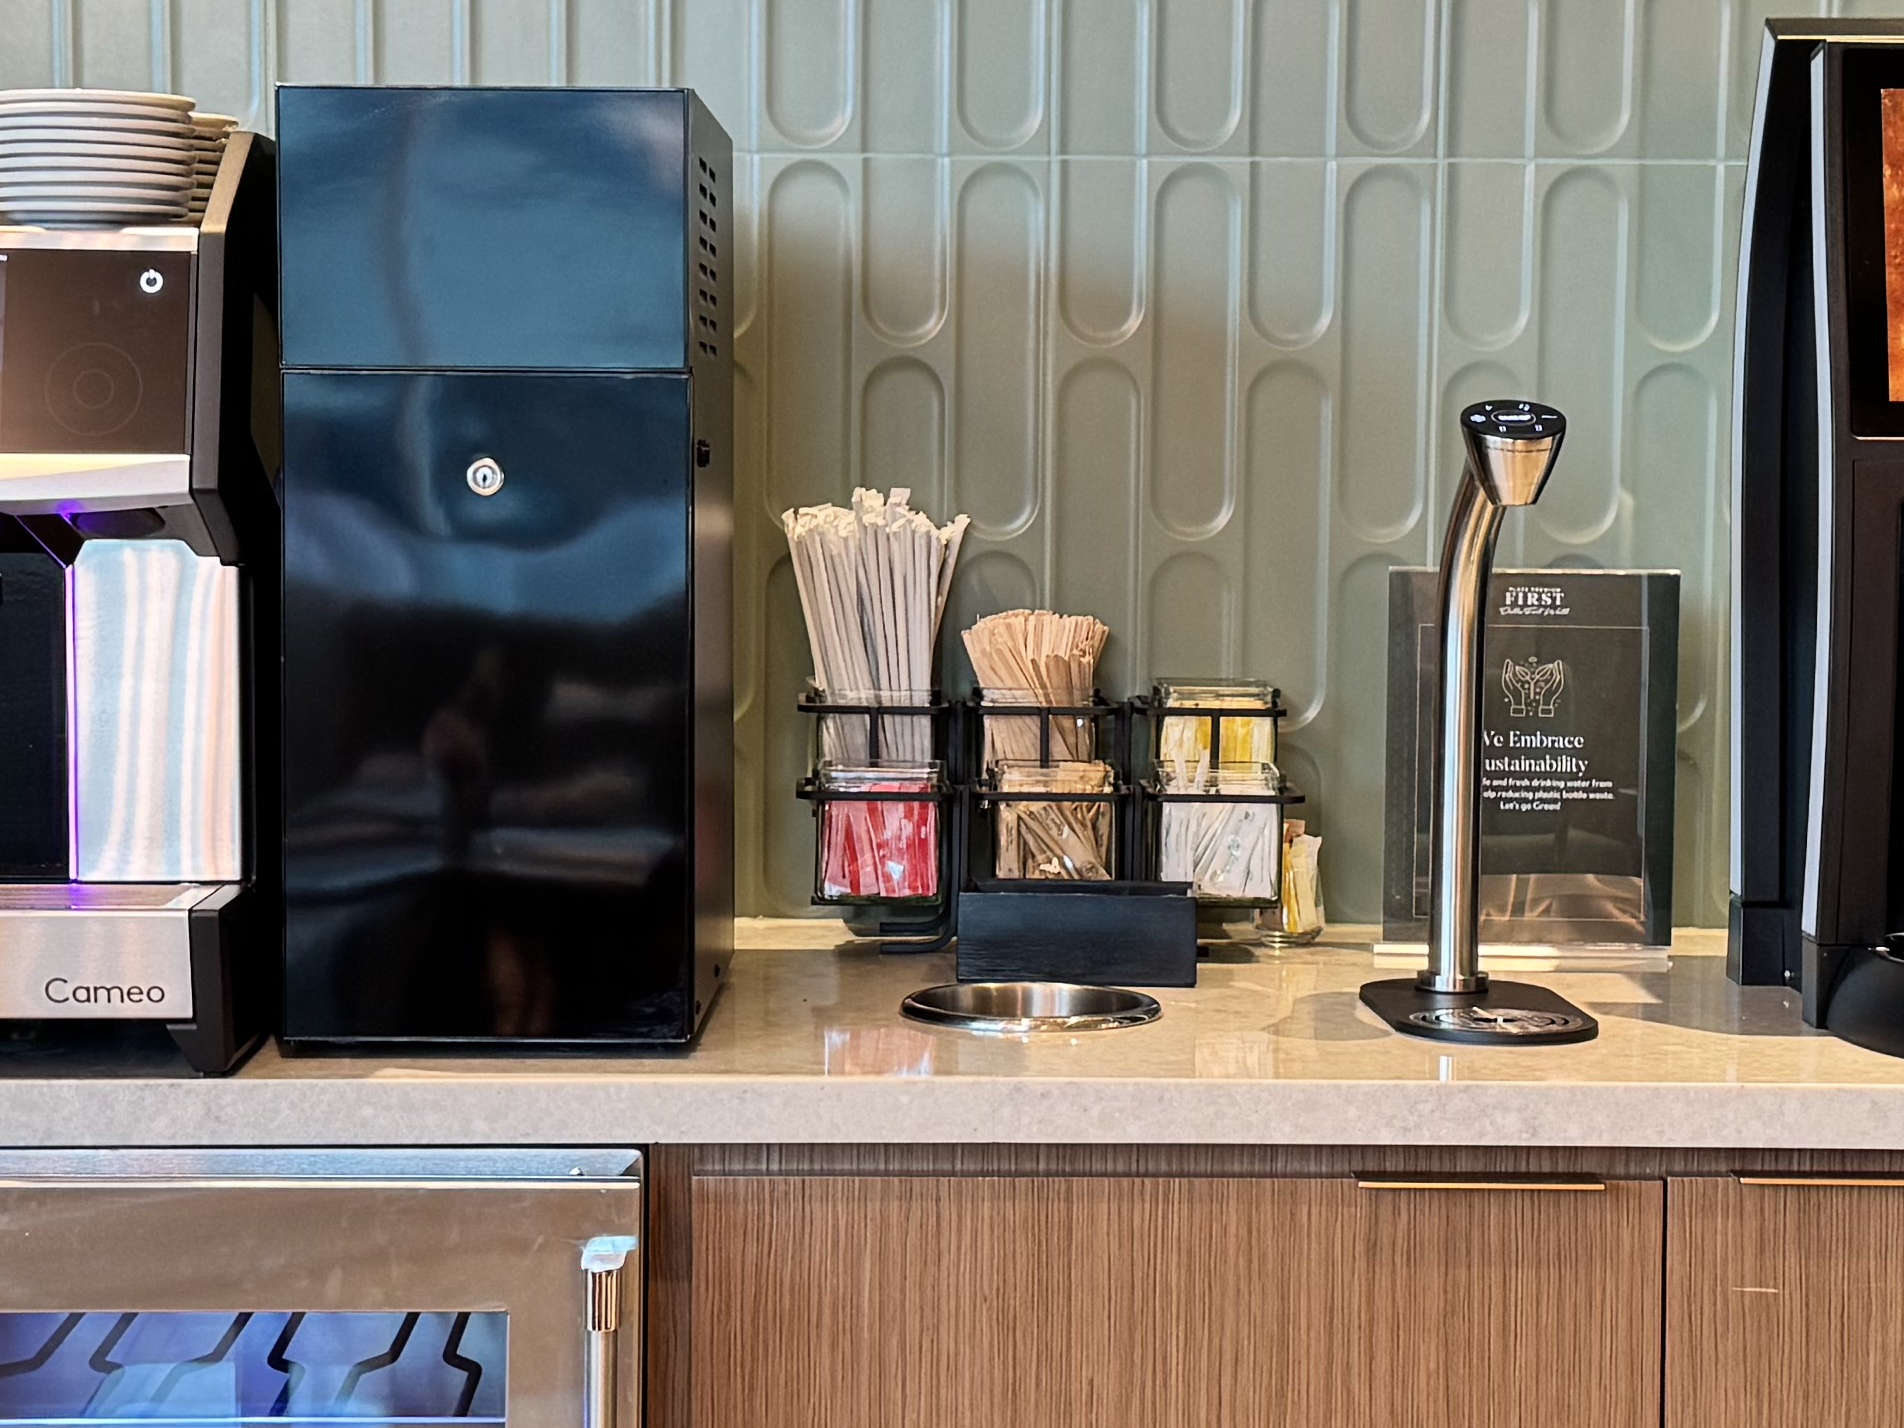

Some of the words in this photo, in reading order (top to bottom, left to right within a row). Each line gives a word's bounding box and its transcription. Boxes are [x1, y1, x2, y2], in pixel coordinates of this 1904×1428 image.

[1505, 592, 1564, 605] FIRST
[1510, 731, 1584, 748] Embrace
[1485, 755, 1588, 777] ustainability
[1492, 778, 1507, 786] and
[1521, 802, 1531, 811] go
[45, 977, 165, 1003] Cameo
